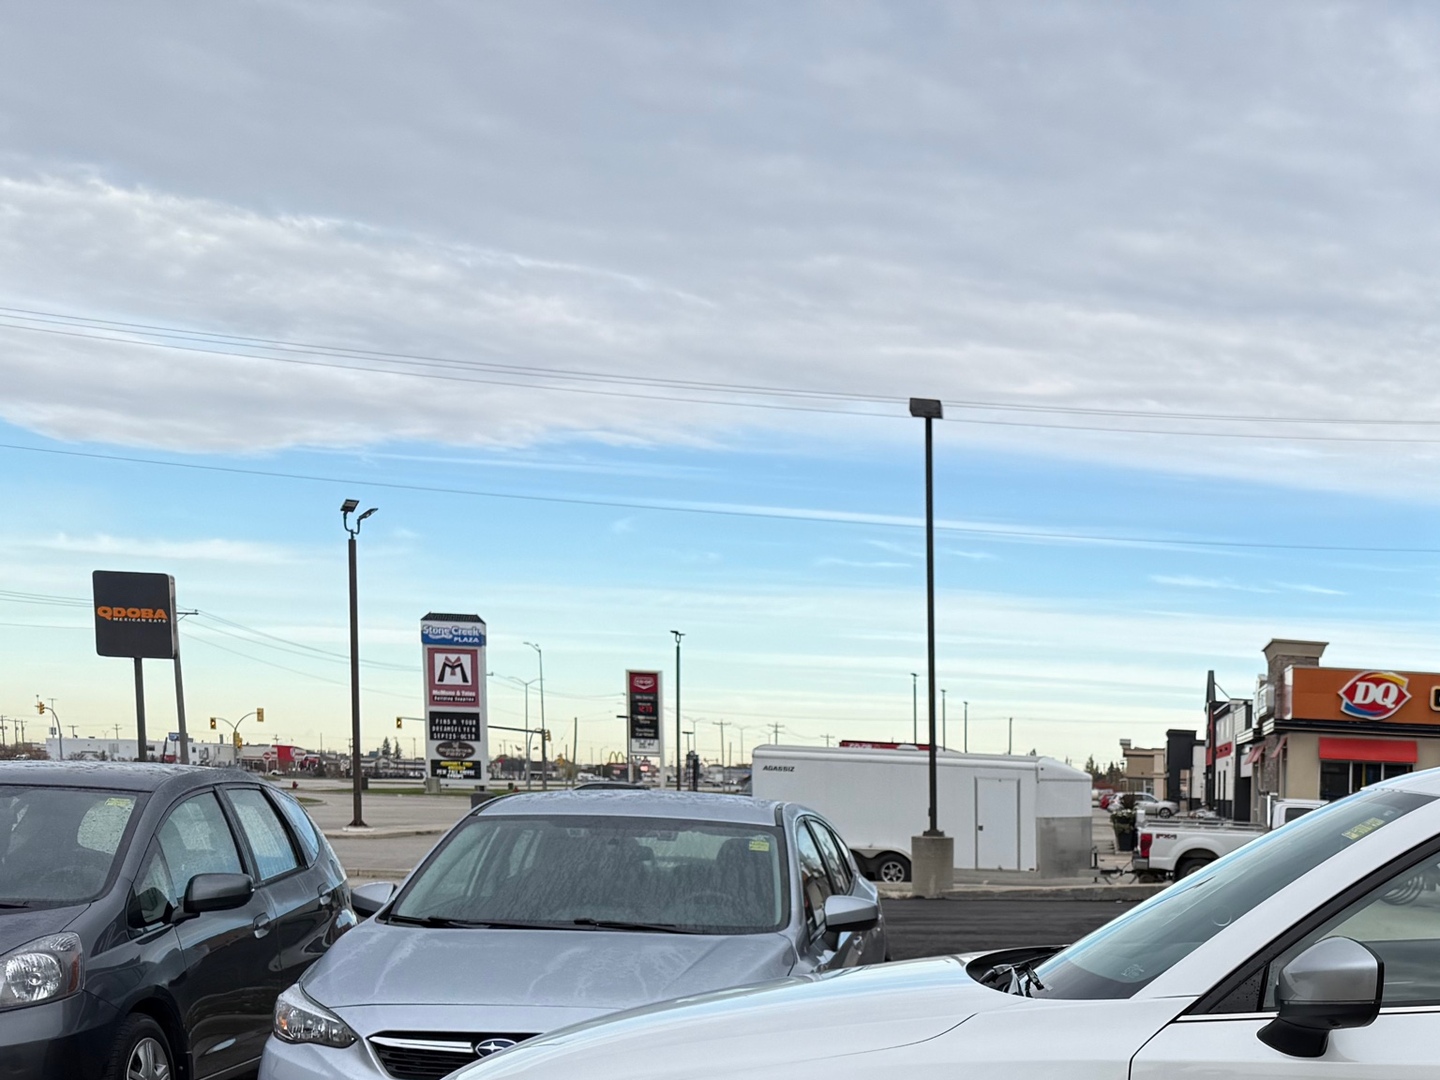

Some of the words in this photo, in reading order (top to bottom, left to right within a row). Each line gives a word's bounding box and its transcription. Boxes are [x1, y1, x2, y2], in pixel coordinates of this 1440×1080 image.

[97, 606, 168, 621] QDOBA
[423, 625, 452, 635] Stone
[451, 626, 480, 637] Creek
[1352, 681, 1399, 709] DQ
